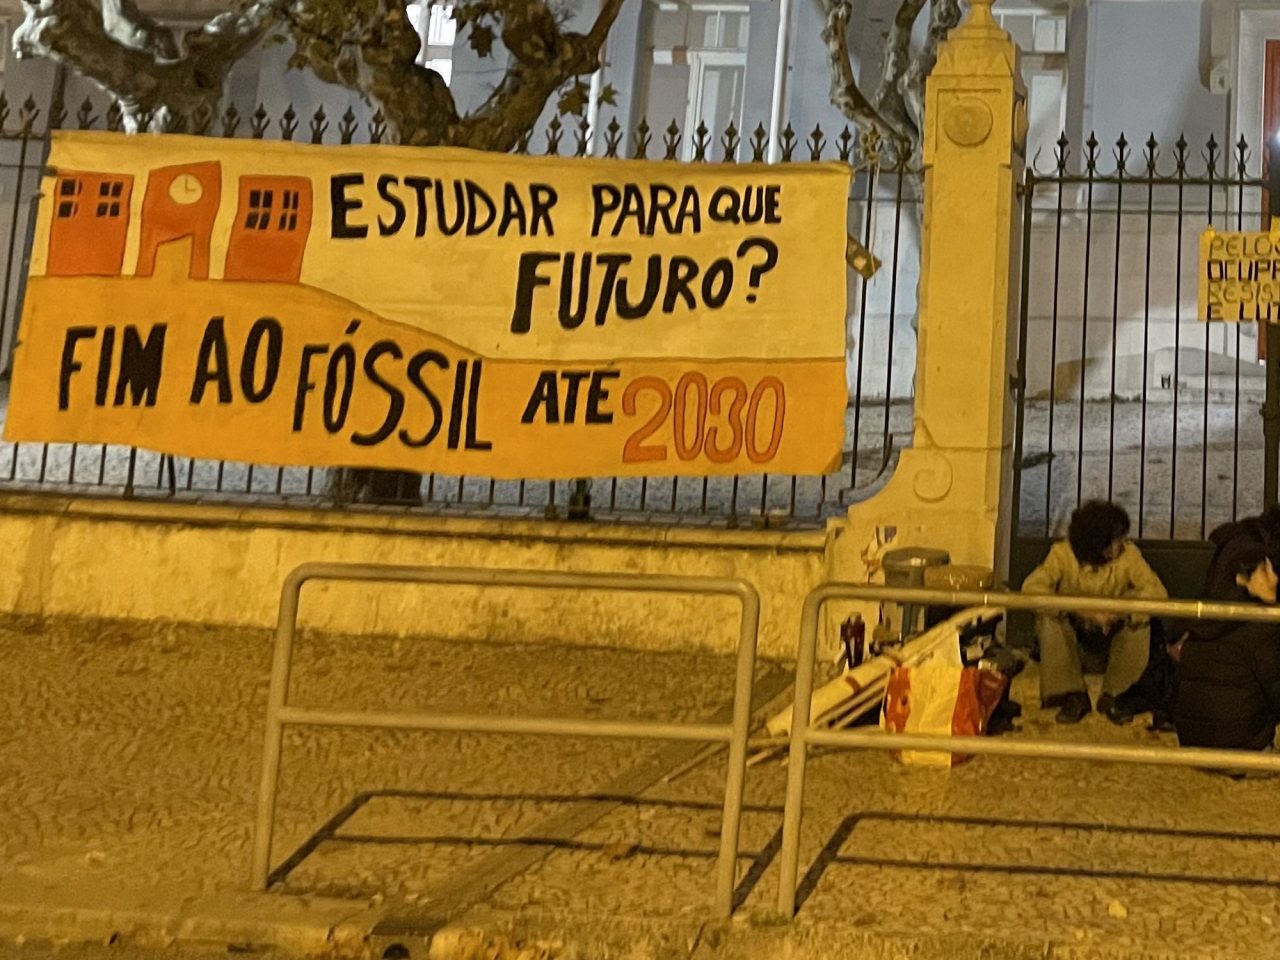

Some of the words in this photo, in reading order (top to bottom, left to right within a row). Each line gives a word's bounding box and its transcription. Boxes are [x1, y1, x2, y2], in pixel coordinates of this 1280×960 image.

[330, 172, 558, 239] ESTUDAR
[591, 183, 701, 237] PARA
[708, 185, 782, 225] QUE
[510, 236, 779, 334] FUTURO?
[1207, 303, 1223, 321] E
[58, 323, 168, 411] FIM
[189, 316, 283, 405] AO
[292, 319, 493, 452] FÓSSIL
[621, 370, 786, 464] 2030
